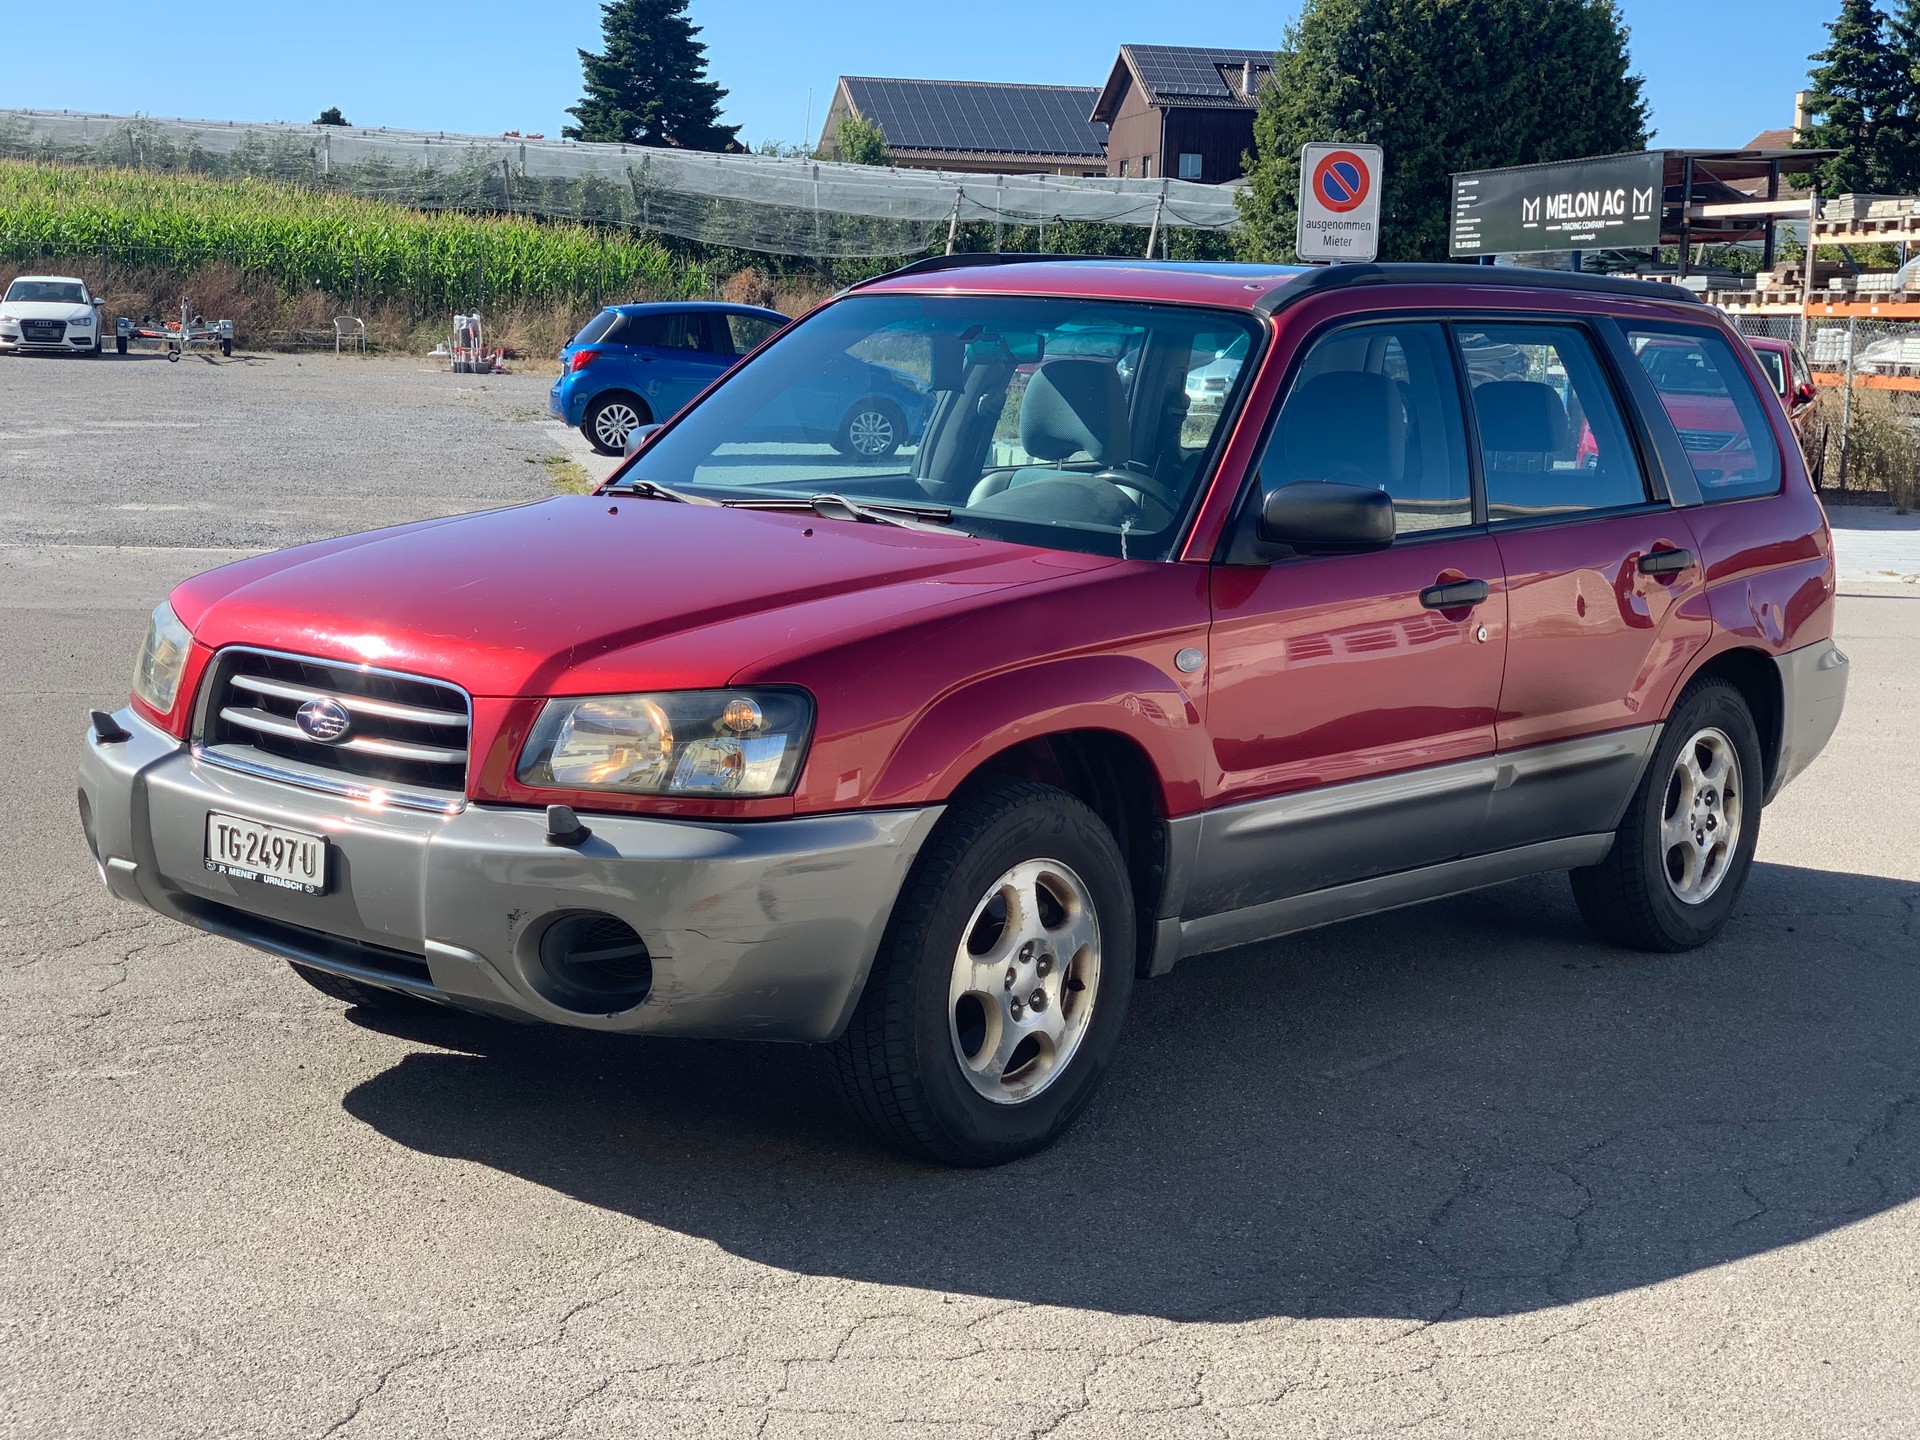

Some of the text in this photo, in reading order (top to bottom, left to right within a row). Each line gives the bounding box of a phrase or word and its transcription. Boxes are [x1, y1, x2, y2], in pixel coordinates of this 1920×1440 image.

[1545, 191, 1600, 220] MELON
[1601, 188, 1626, 216] AG
[1306, 220, 1371, 232] ausgenommen
[1323, 235, 1352, 247] Mieter
[218, 866, 303, 891] P. MENET URNASCH
